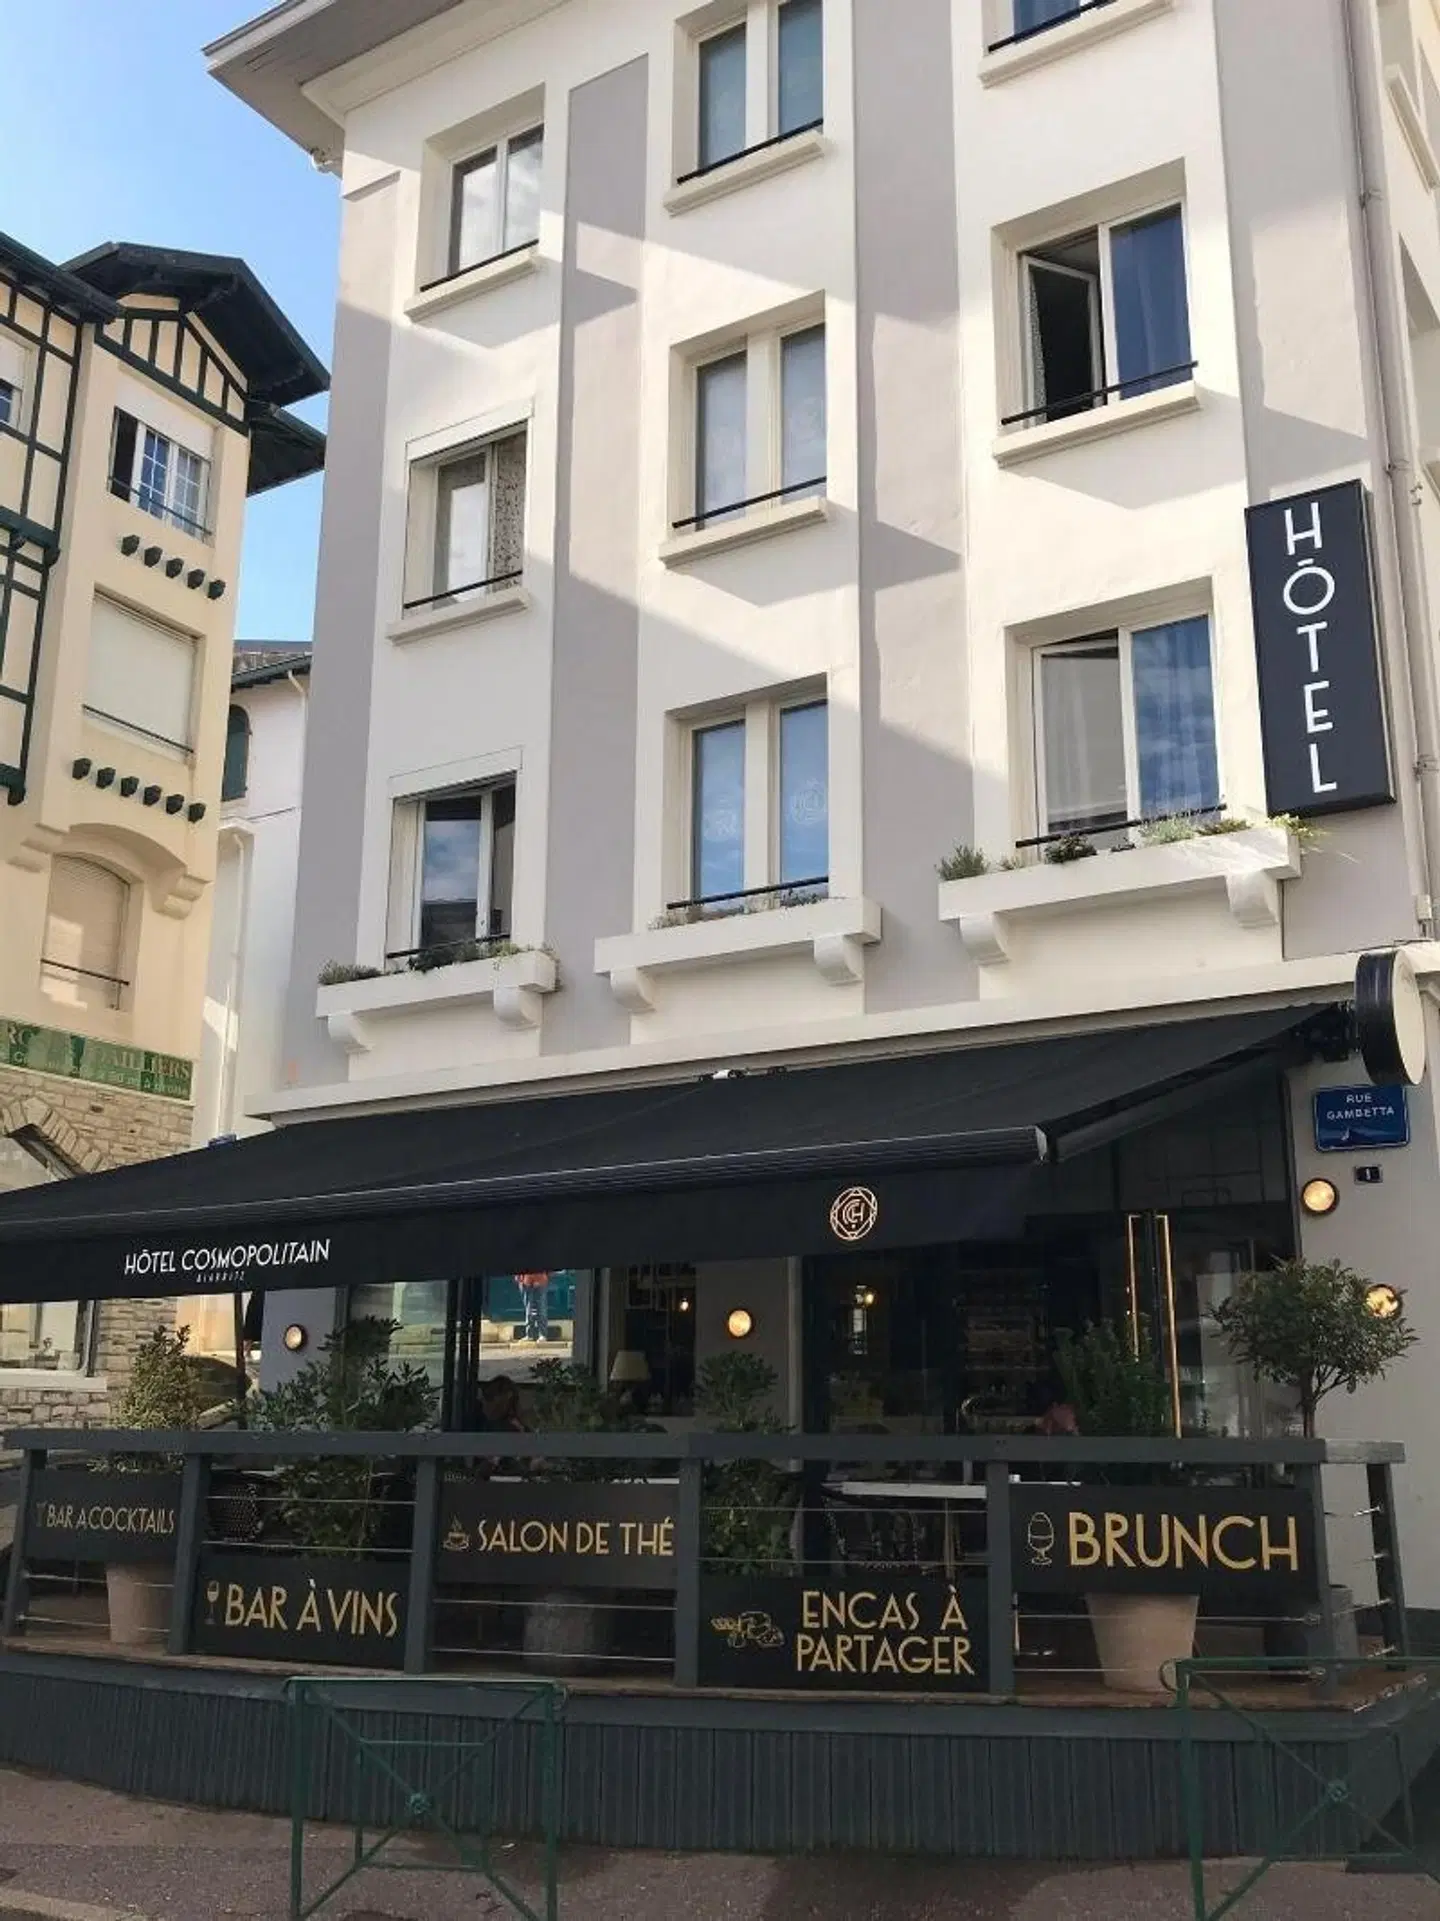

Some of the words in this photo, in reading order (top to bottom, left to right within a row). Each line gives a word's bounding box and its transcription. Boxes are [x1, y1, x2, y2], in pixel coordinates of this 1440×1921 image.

[1283, 502, 1337, 793] HÔTEL
[1326, 1106, 1394, 1120] GAMBETTA
[1346, 1093, 1372, 1103] RUE
[124, 1249, 176, 1275] HÔTEL
[181, 1239, 331, 1270] COSMOPOLITAIN
[46, 1504, 73, 1528] BAR
[88, 1506, 175, 1534] COCKTAILS
[478, 1519, 569, 1553] SALON
[576, 1522, 610, 1554] DE
[619, 1515, 675, 1556] THÉ
[1068, 1511, 1299, 1571] BRUNCH
[224, 1583, 288, 1630] BAR
[296, 1578, 322, 1633] À
[327, 1588, 399, 1638] VINS
[802, 1591, 920, 1630] ENCAS
[940, 1584, 968, 1631] À
[796, 1633, 975, 1676] PARTAGER
